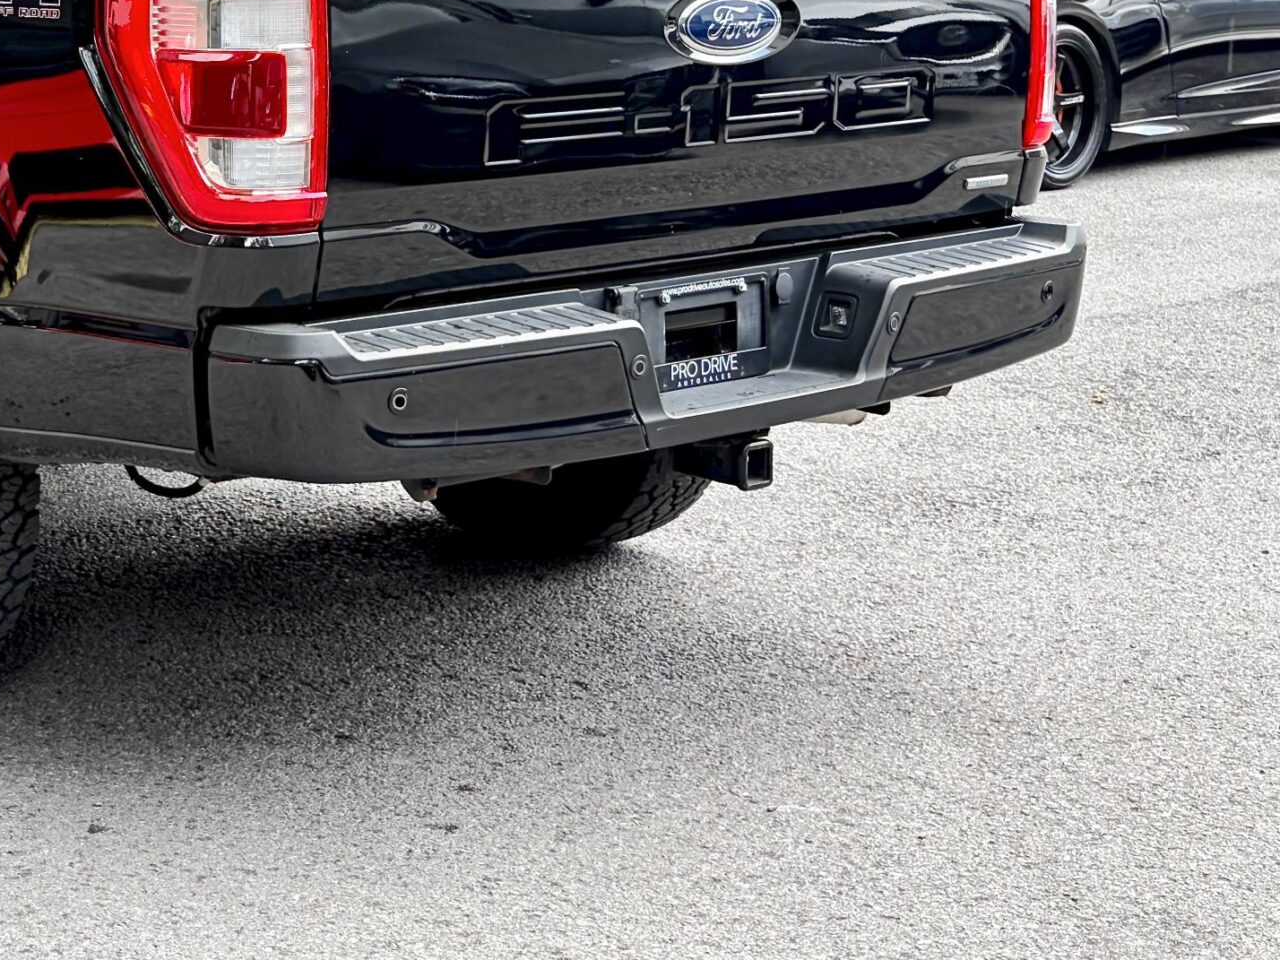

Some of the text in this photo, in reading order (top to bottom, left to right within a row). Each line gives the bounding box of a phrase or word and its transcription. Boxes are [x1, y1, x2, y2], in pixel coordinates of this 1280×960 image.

[18, 7, 60, 19] ROAD
[707, 5, 764, 41] Ford
[483, 64, 935, 167] F-150
[671, 353, 738, 381] PRO DRIVE
[677, 372, 732, 388] AUTOSALES
